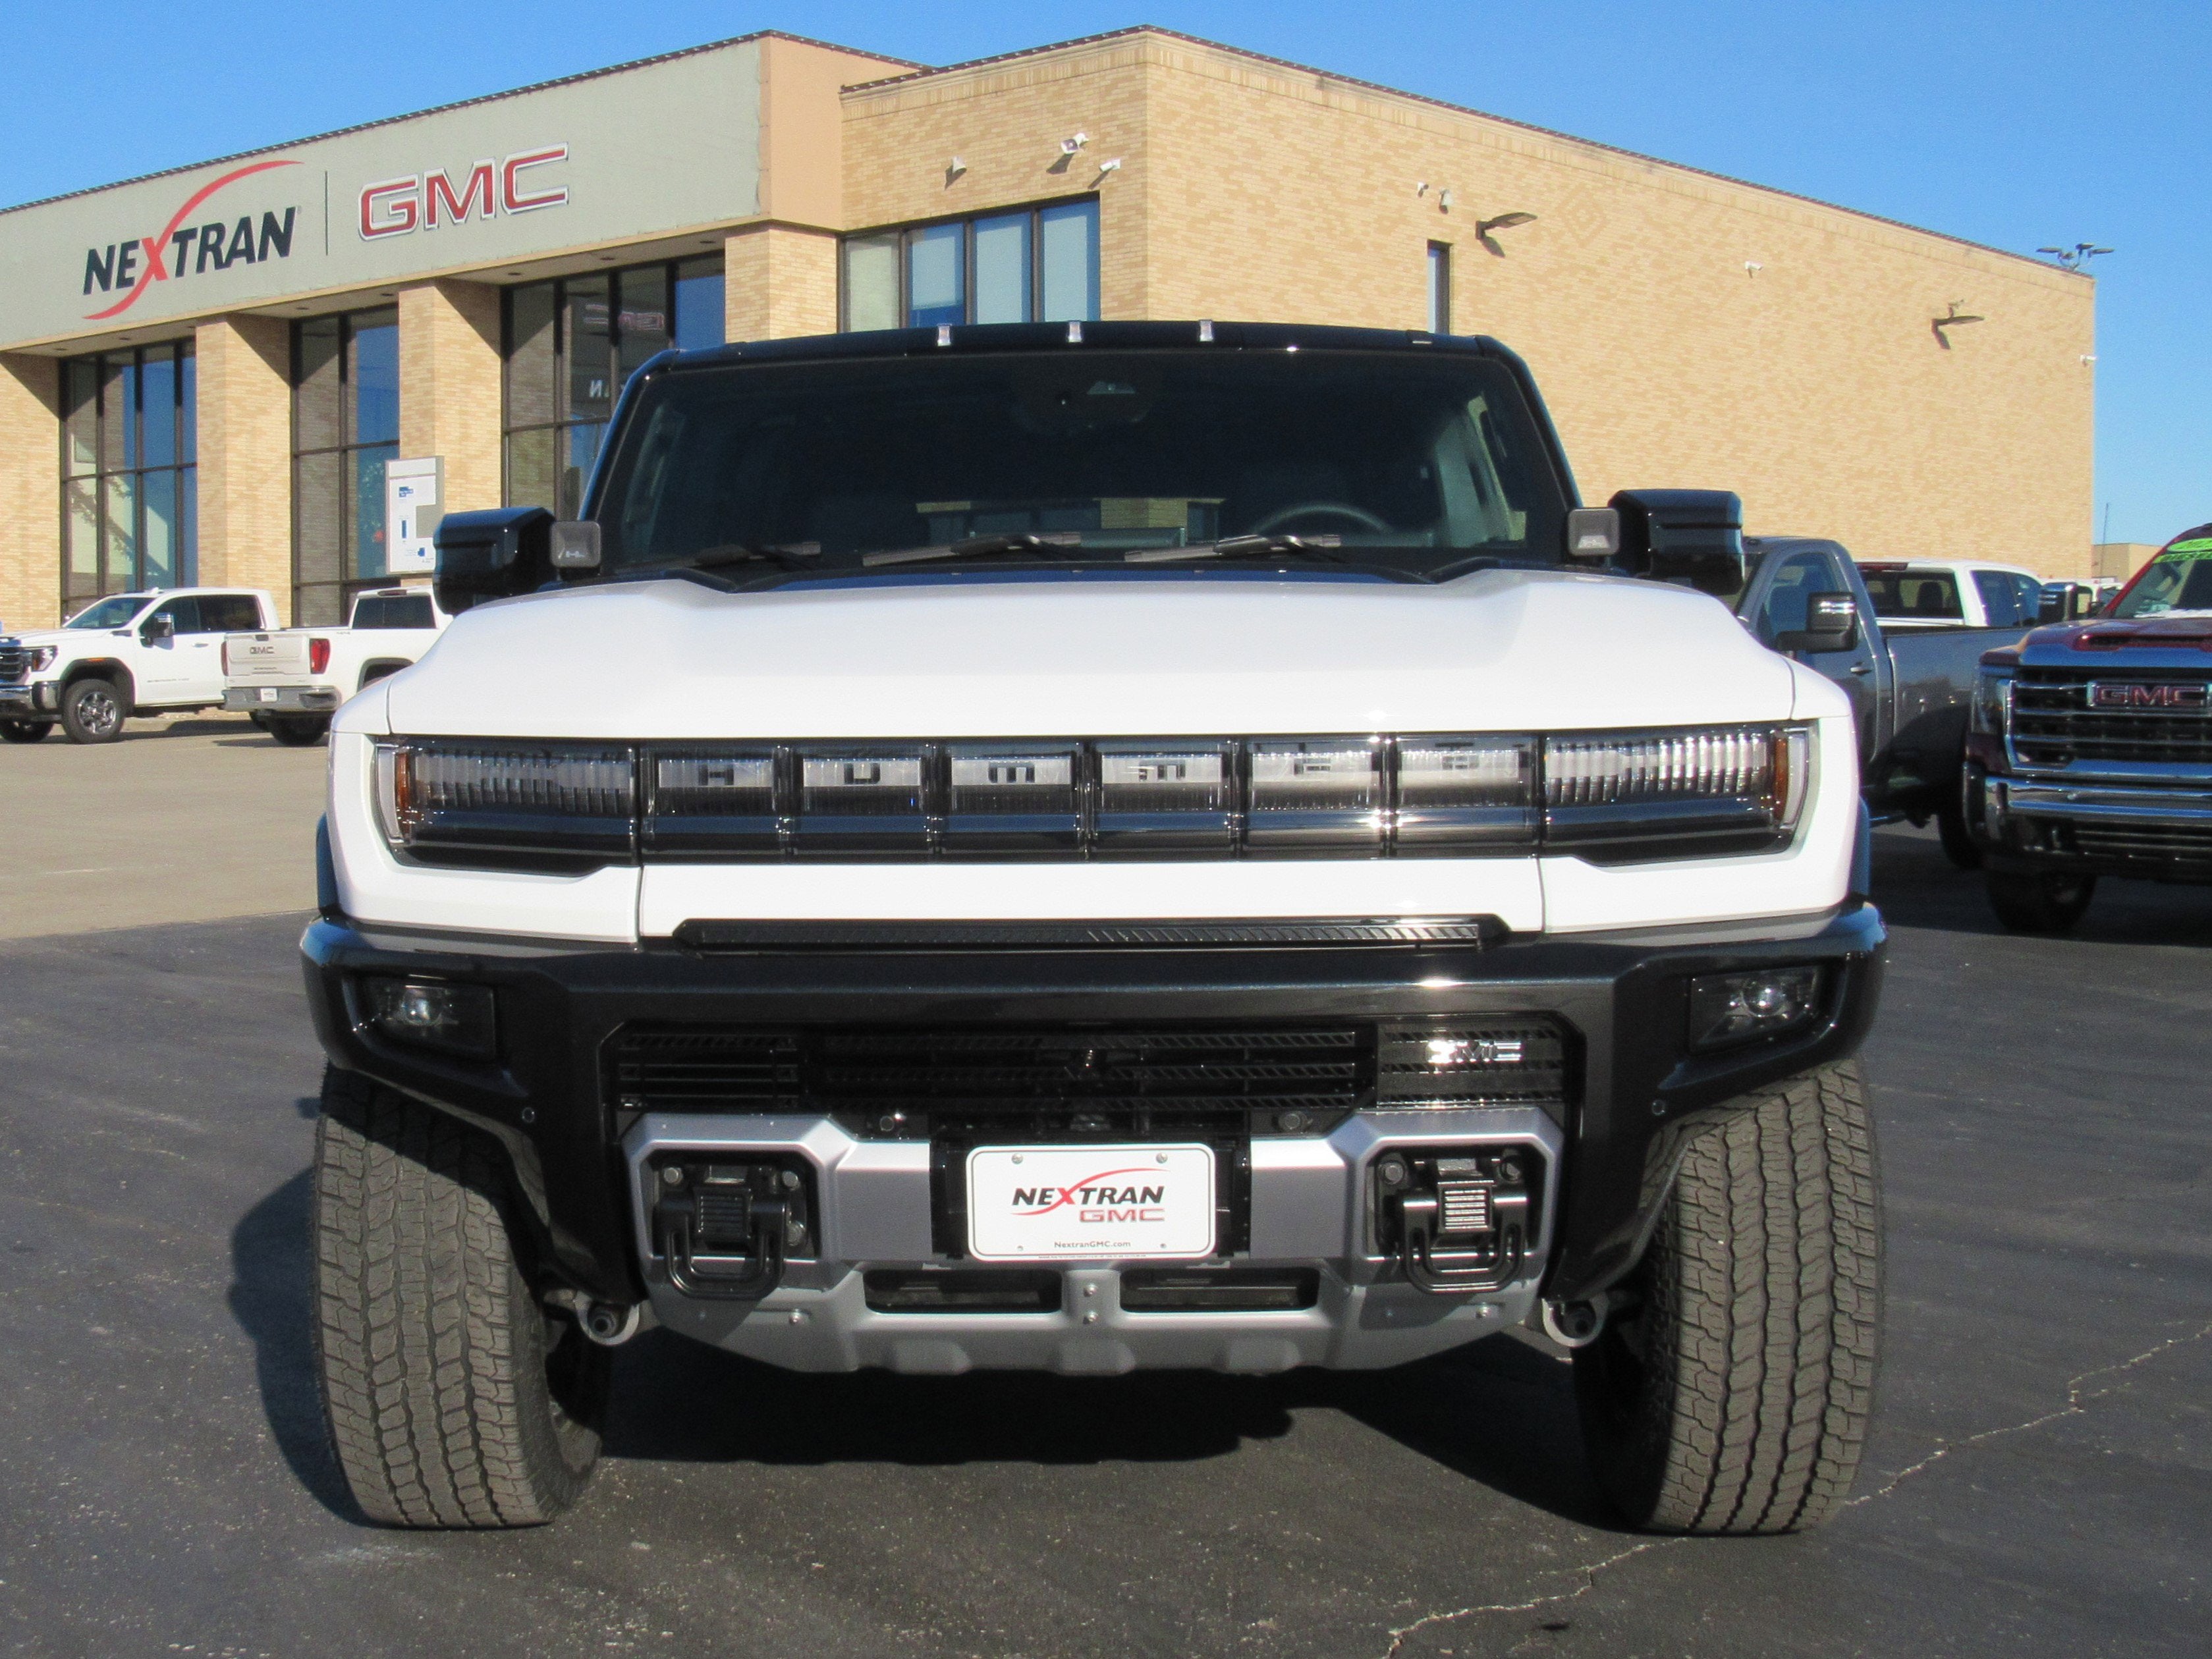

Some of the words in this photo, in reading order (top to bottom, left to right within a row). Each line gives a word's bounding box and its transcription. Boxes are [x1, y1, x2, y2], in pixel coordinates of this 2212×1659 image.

[358, 142, 569, 241] GMC
[82, 205, 296, 296] NEXTRAN
[250, 645, 274, 654] GMC
[2095, 685, 2204, 706] GMC
[1011, 1185, 1165, 1206] NEXTRAN
[1079, 1208, 1165, 1223] GMC
[1053, 1240, 1131, 1249] NextranGMC.com
